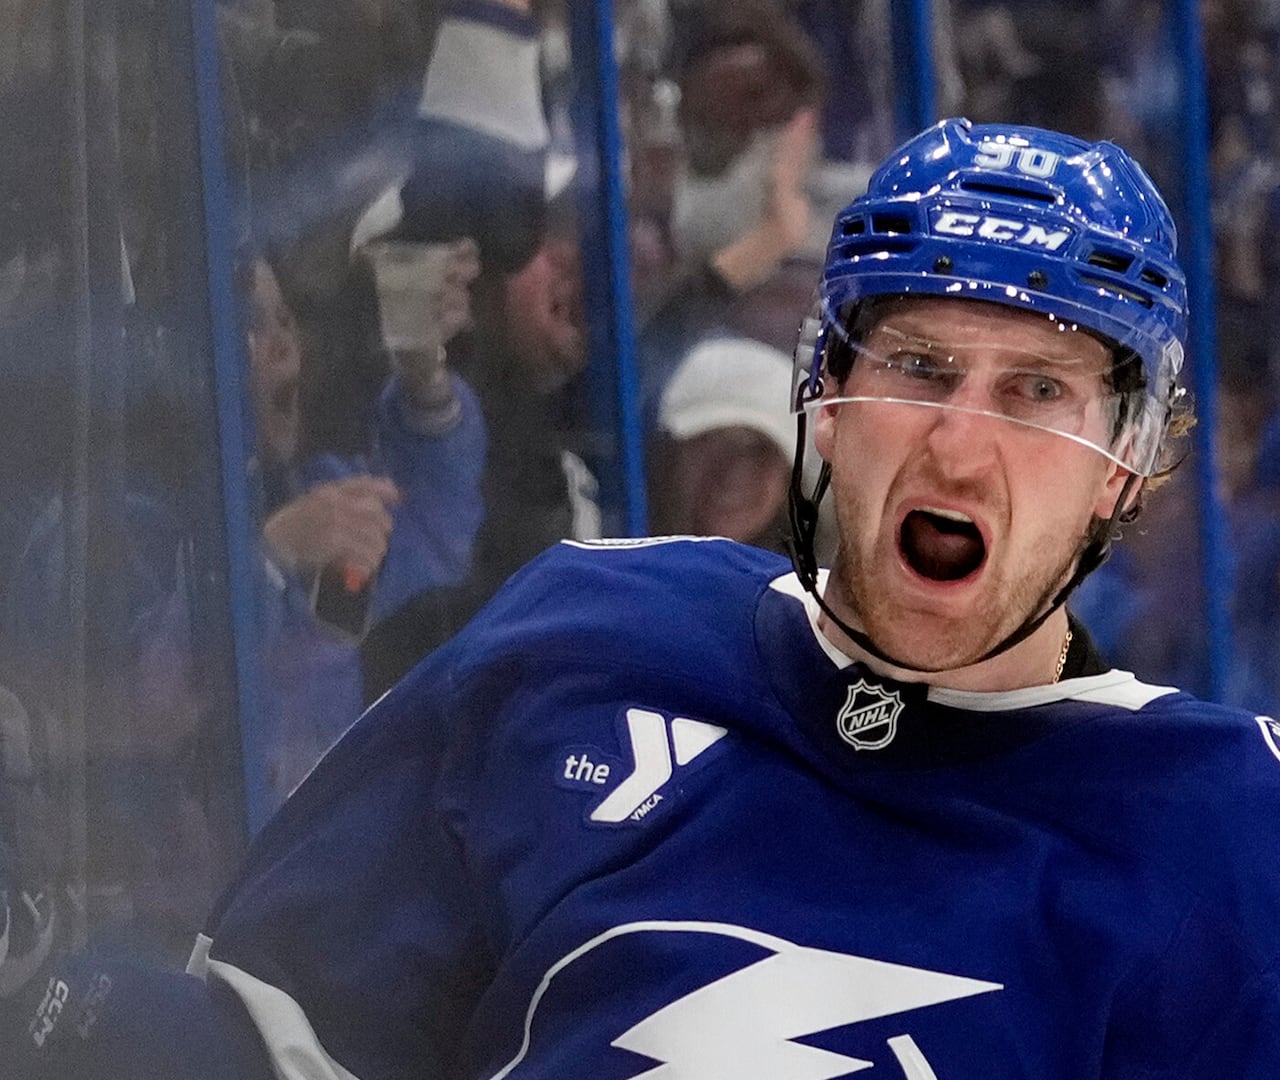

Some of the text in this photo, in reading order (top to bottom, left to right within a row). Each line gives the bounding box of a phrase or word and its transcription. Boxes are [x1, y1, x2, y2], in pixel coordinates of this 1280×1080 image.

[934, 212, 1069, 251] CCM
[848, 705, 889, 731] NHL
[564, 754, 610, 784] the
[630, 793, 664, 821] YMCA
